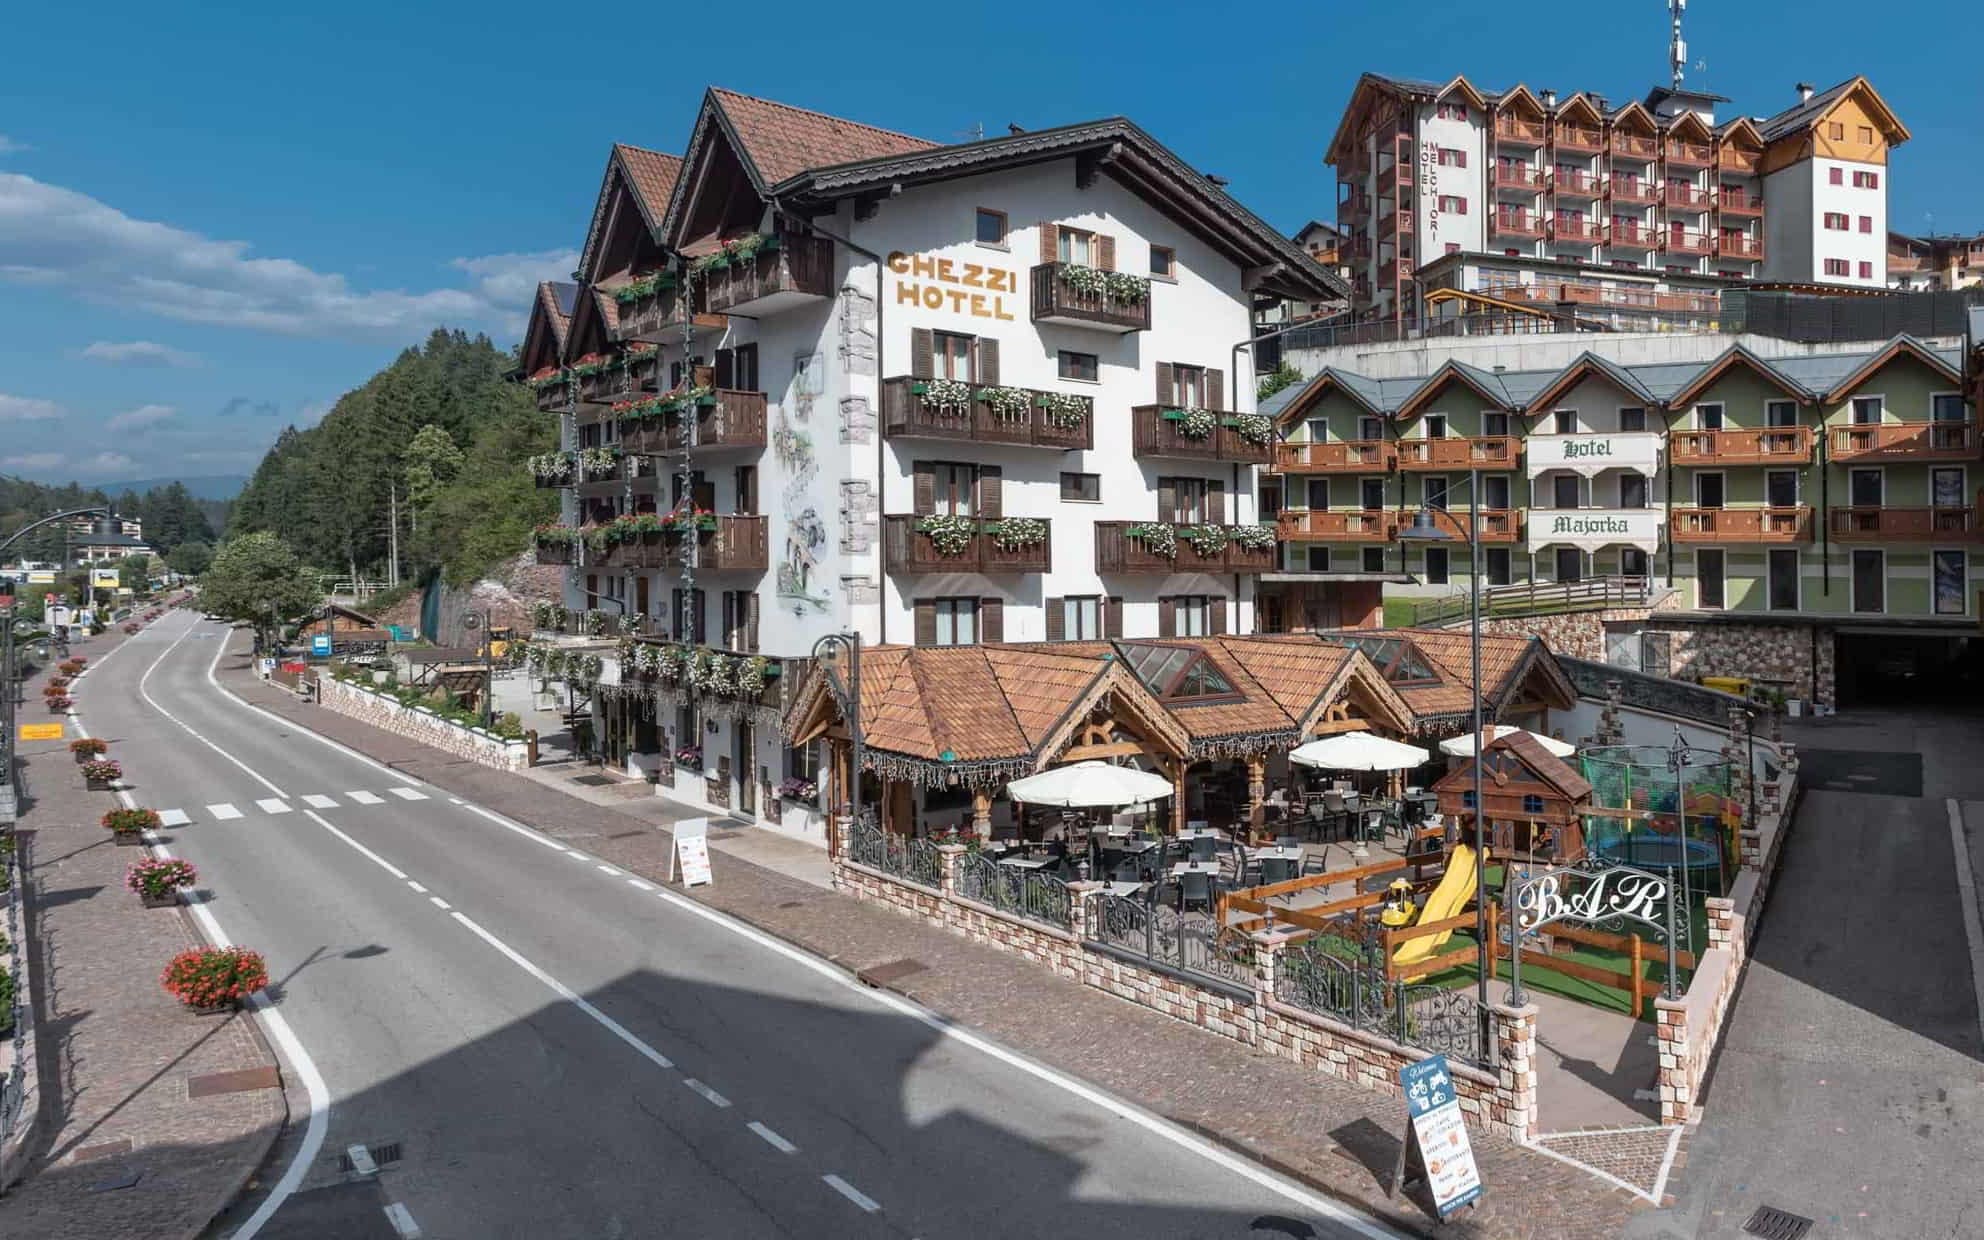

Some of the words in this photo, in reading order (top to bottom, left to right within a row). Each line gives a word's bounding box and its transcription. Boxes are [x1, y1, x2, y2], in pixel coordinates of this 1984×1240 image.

[1420, 140, 1428, 196] HOTEL
[1429, 139, 1439, 242] MELCHIORI
[887, 250, 1017, 293] GHEZZI
[896, 280, 1014, 321] HOTEL
[1562, 439, 1613, 459] Hotel
[1551, 516, 1629, 535] Majorka
[1517, 873, 1667, 928] BAR
